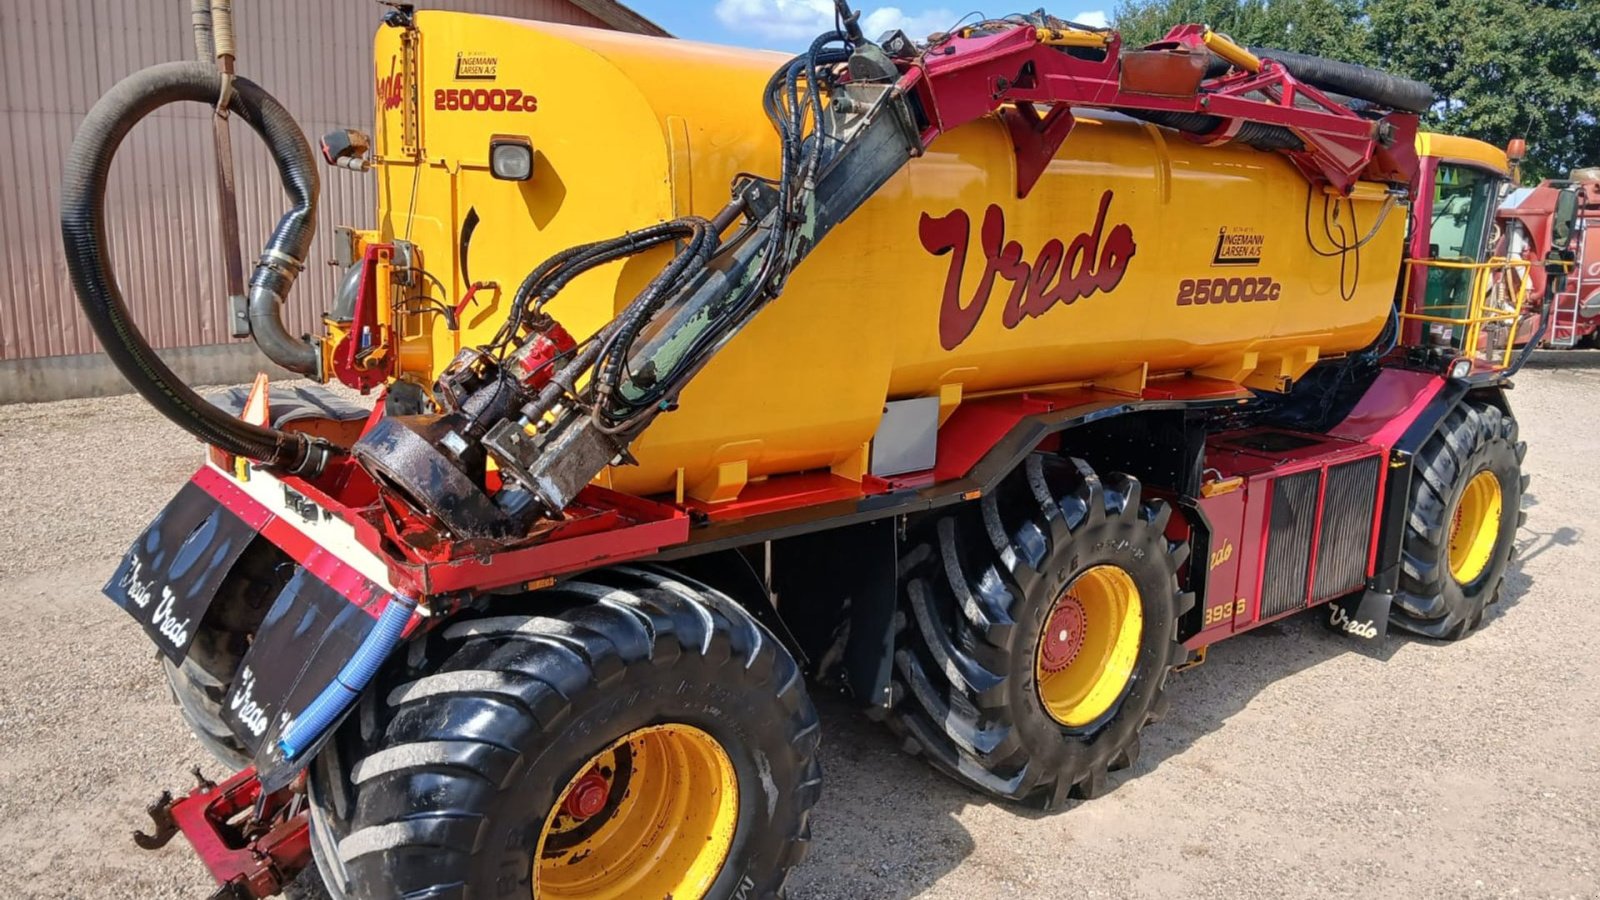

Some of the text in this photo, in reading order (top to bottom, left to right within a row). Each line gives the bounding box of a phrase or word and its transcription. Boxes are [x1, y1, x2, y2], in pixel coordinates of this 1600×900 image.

[460, 66, 496, 75] LARSEN A/S
[434, 88, 538, 112] 25000Zc
[1221, 246, 1262, 257] LARSEN A/S
[918, 189, 1137, 351] Vredo
[1176, 277, 1281, 306] 25000Zc
[1210, 538, 1233, 571] edo
[152, 585, 190, 648] Vredo
[1328, 602, 1378, 639] Vredo
[230, 665, 271, 737] Vredo
